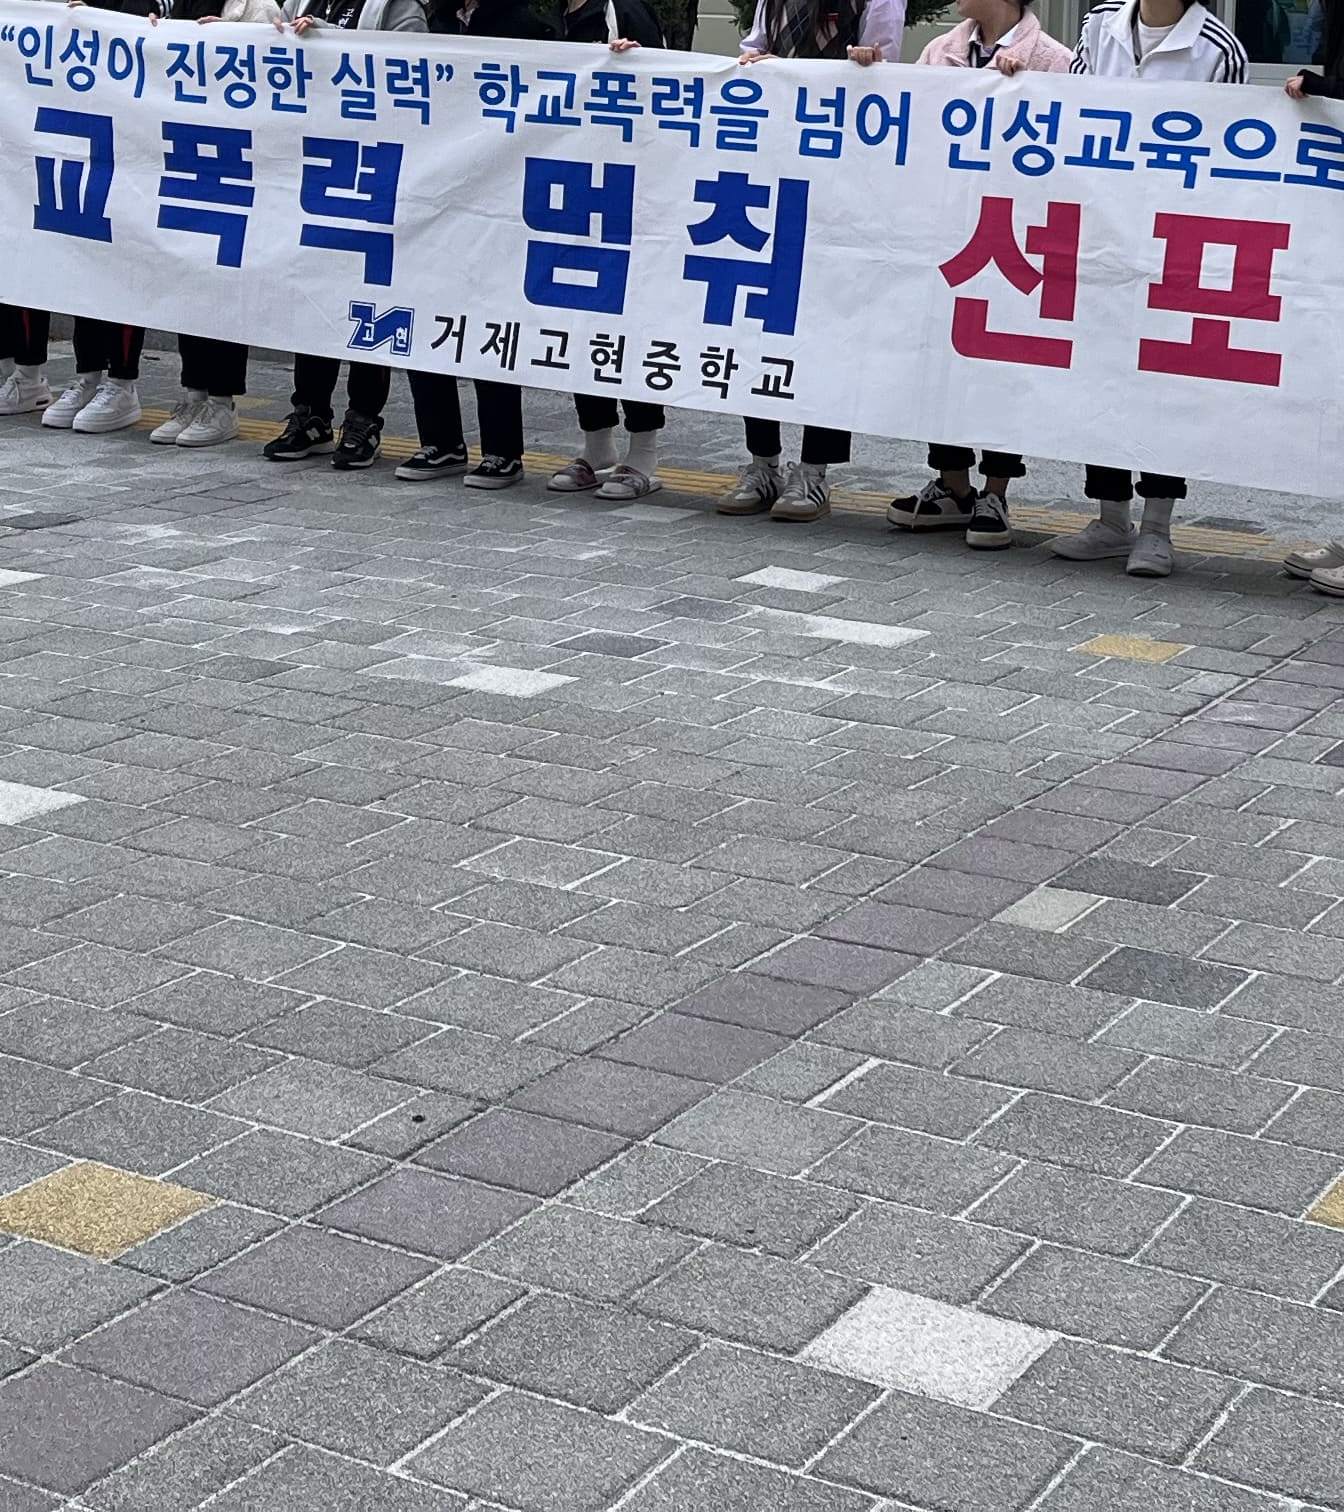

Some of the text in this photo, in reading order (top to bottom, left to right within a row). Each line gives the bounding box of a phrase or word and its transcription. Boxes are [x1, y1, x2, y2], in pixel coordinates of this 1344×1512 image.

[167, 42, 312, 113] 진정한
[474, 63, 768, 152] 학교폭력을
[796, 87, 910, 165] 넘어
[523, 158, 809, 335] 멈춰
[431, 316, 794, 399] 거제고현중학교
